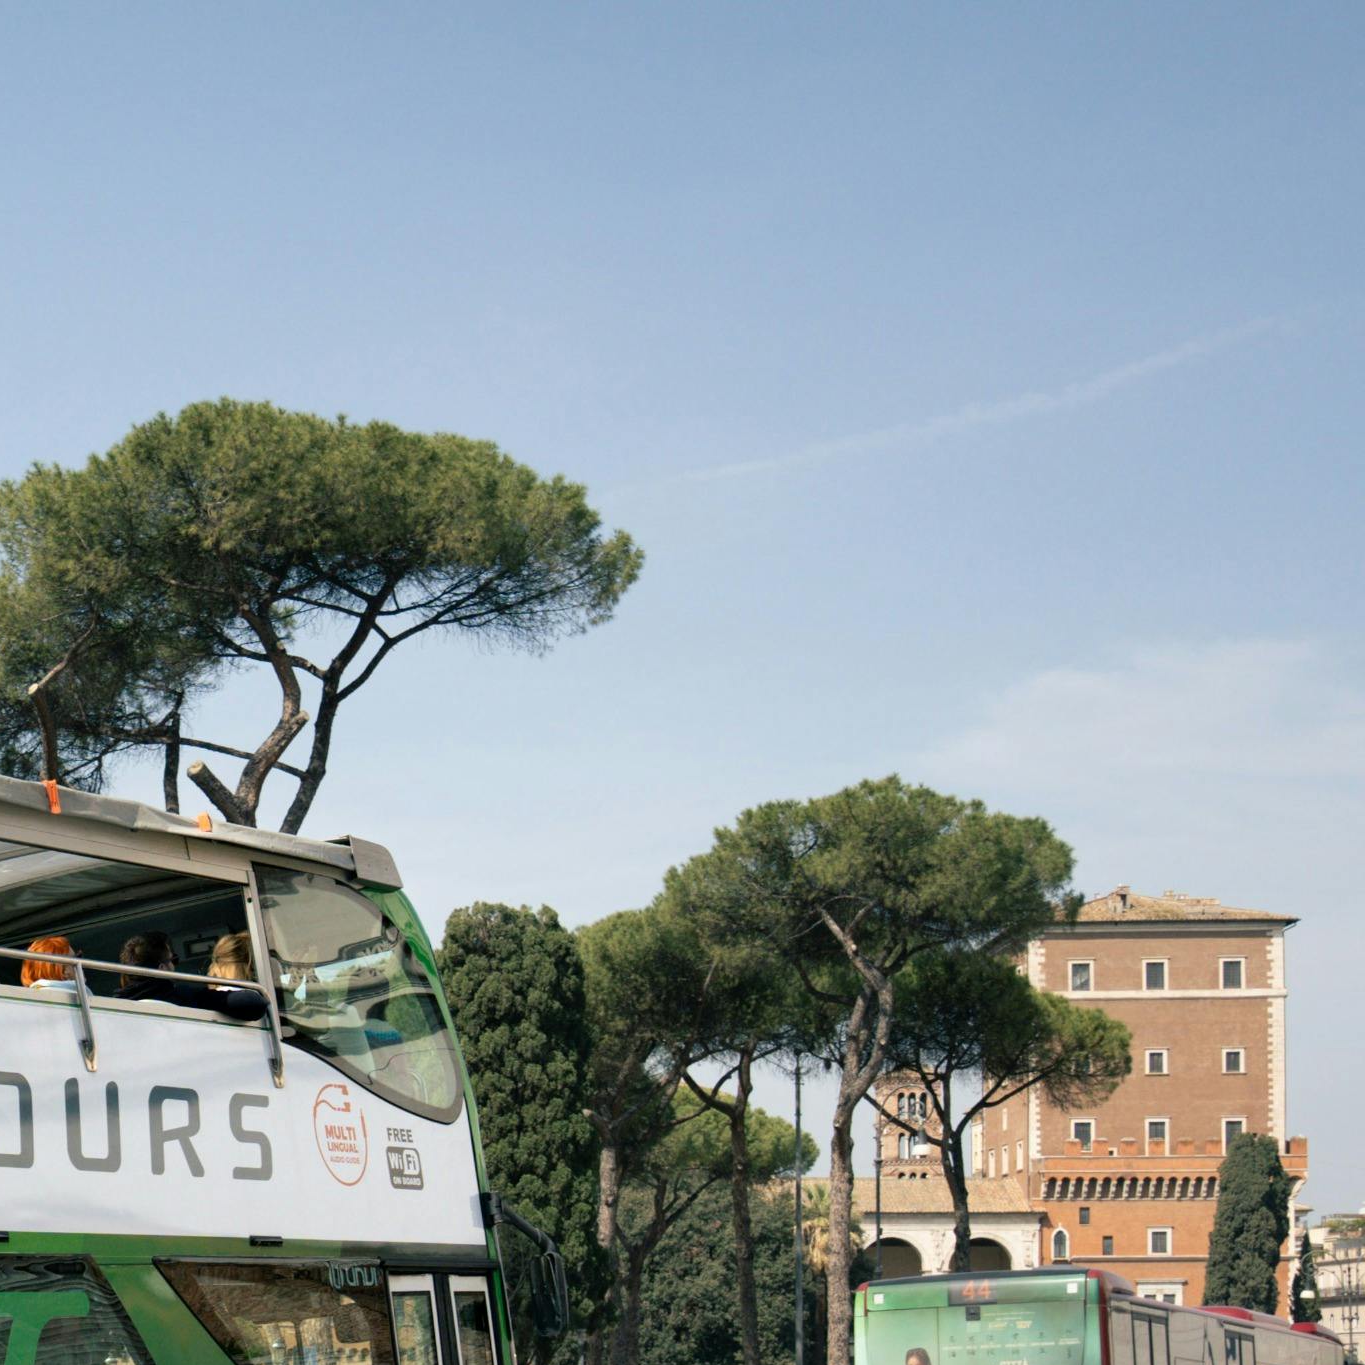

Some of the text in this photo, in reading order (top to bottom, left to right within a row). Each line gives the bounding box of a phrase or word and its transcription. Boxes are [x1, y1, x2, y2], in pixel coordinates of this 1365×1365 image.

[325, 1125, 356, 1141] MULTI
[386, 1127, 413, 1143] FREE
[327, 1142, 359, 1154] LINGUAL
[962, 1279, 989, 1300] 44
